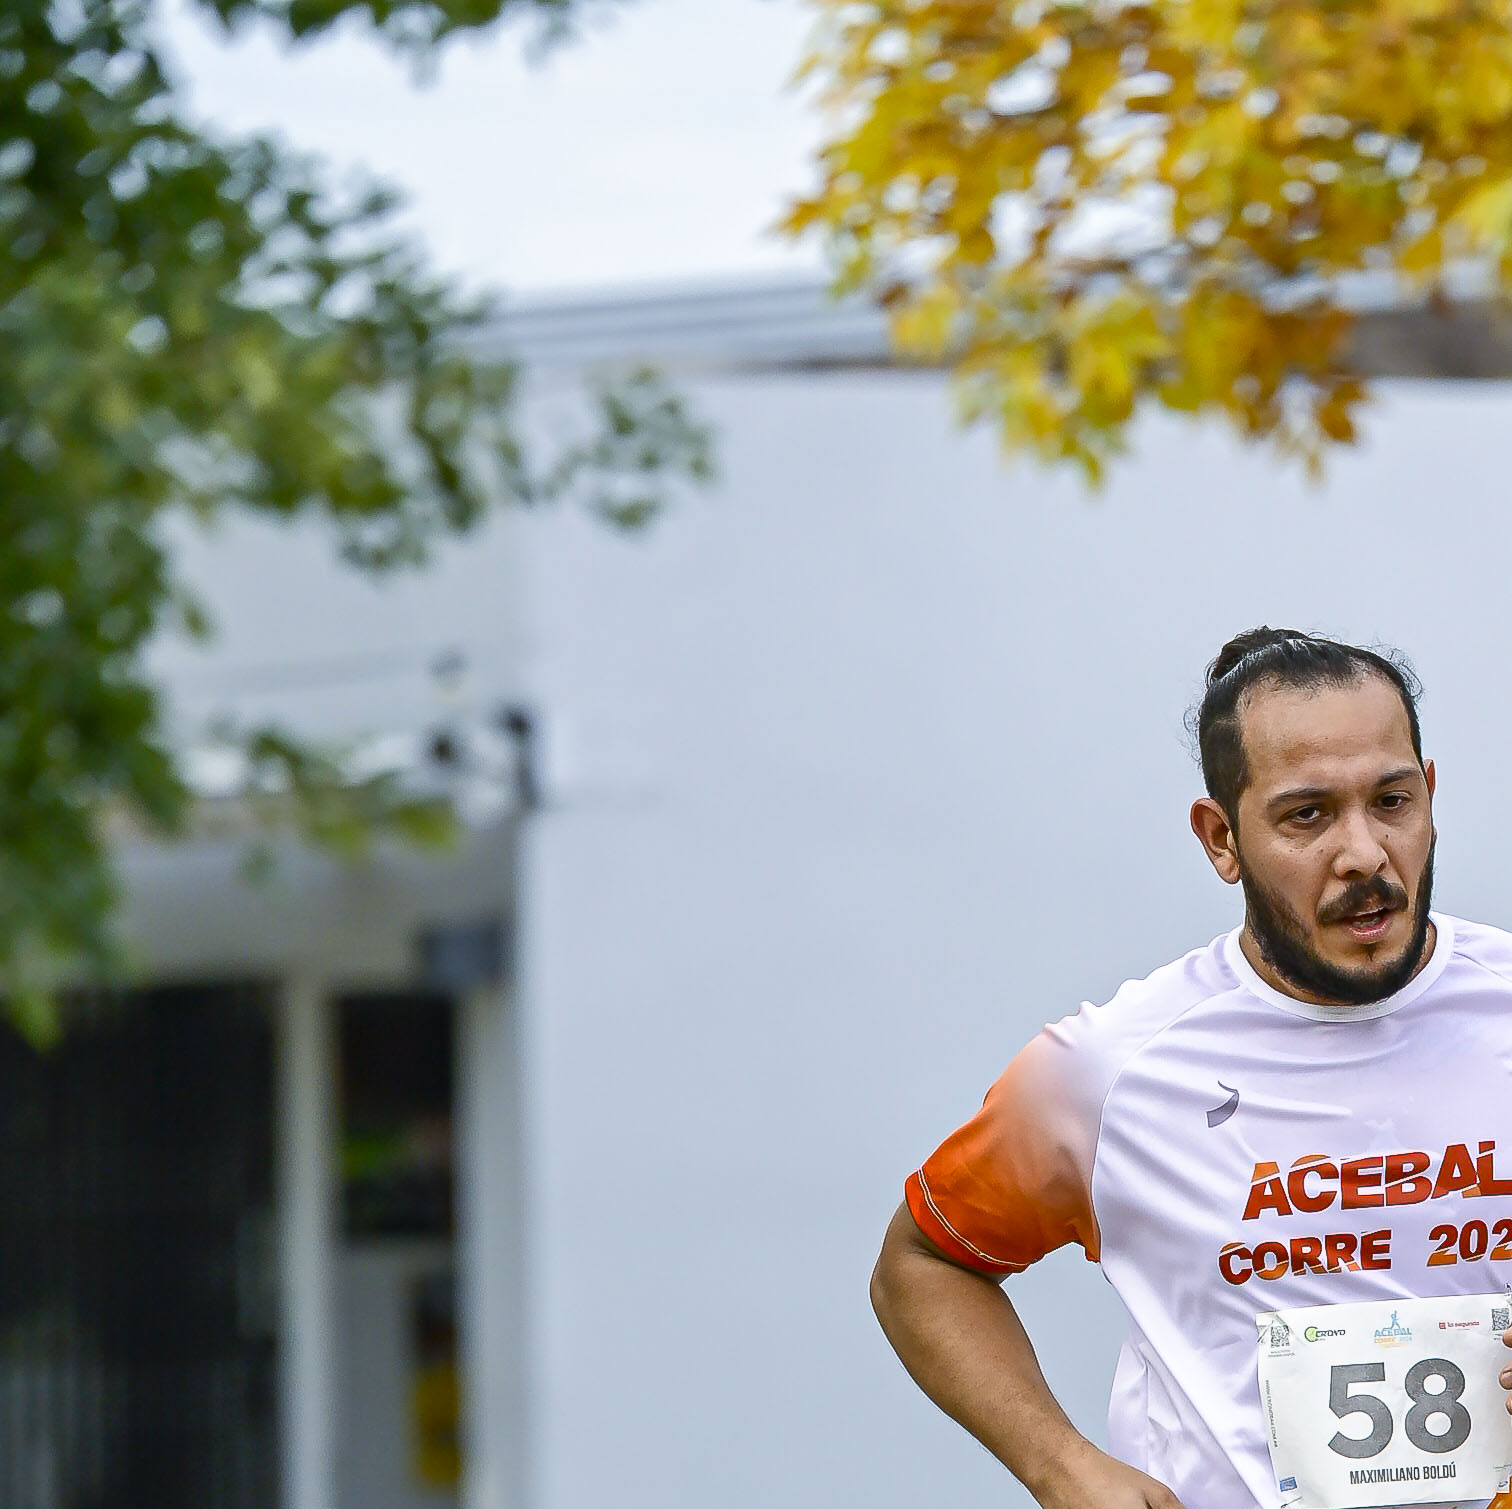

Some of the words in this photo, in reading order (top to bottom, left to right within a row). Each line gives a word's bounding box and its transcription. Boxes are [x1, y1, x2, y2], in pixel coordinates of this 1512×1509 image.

[1219, 1230, 1391, 1285] CORRE
[1328, 1358, 1471, 1459] 58
[1350, 1467, 1420, 1485] MAXIMILIANO
[1423, 1461, 1456, 1480] BOLDÚ
